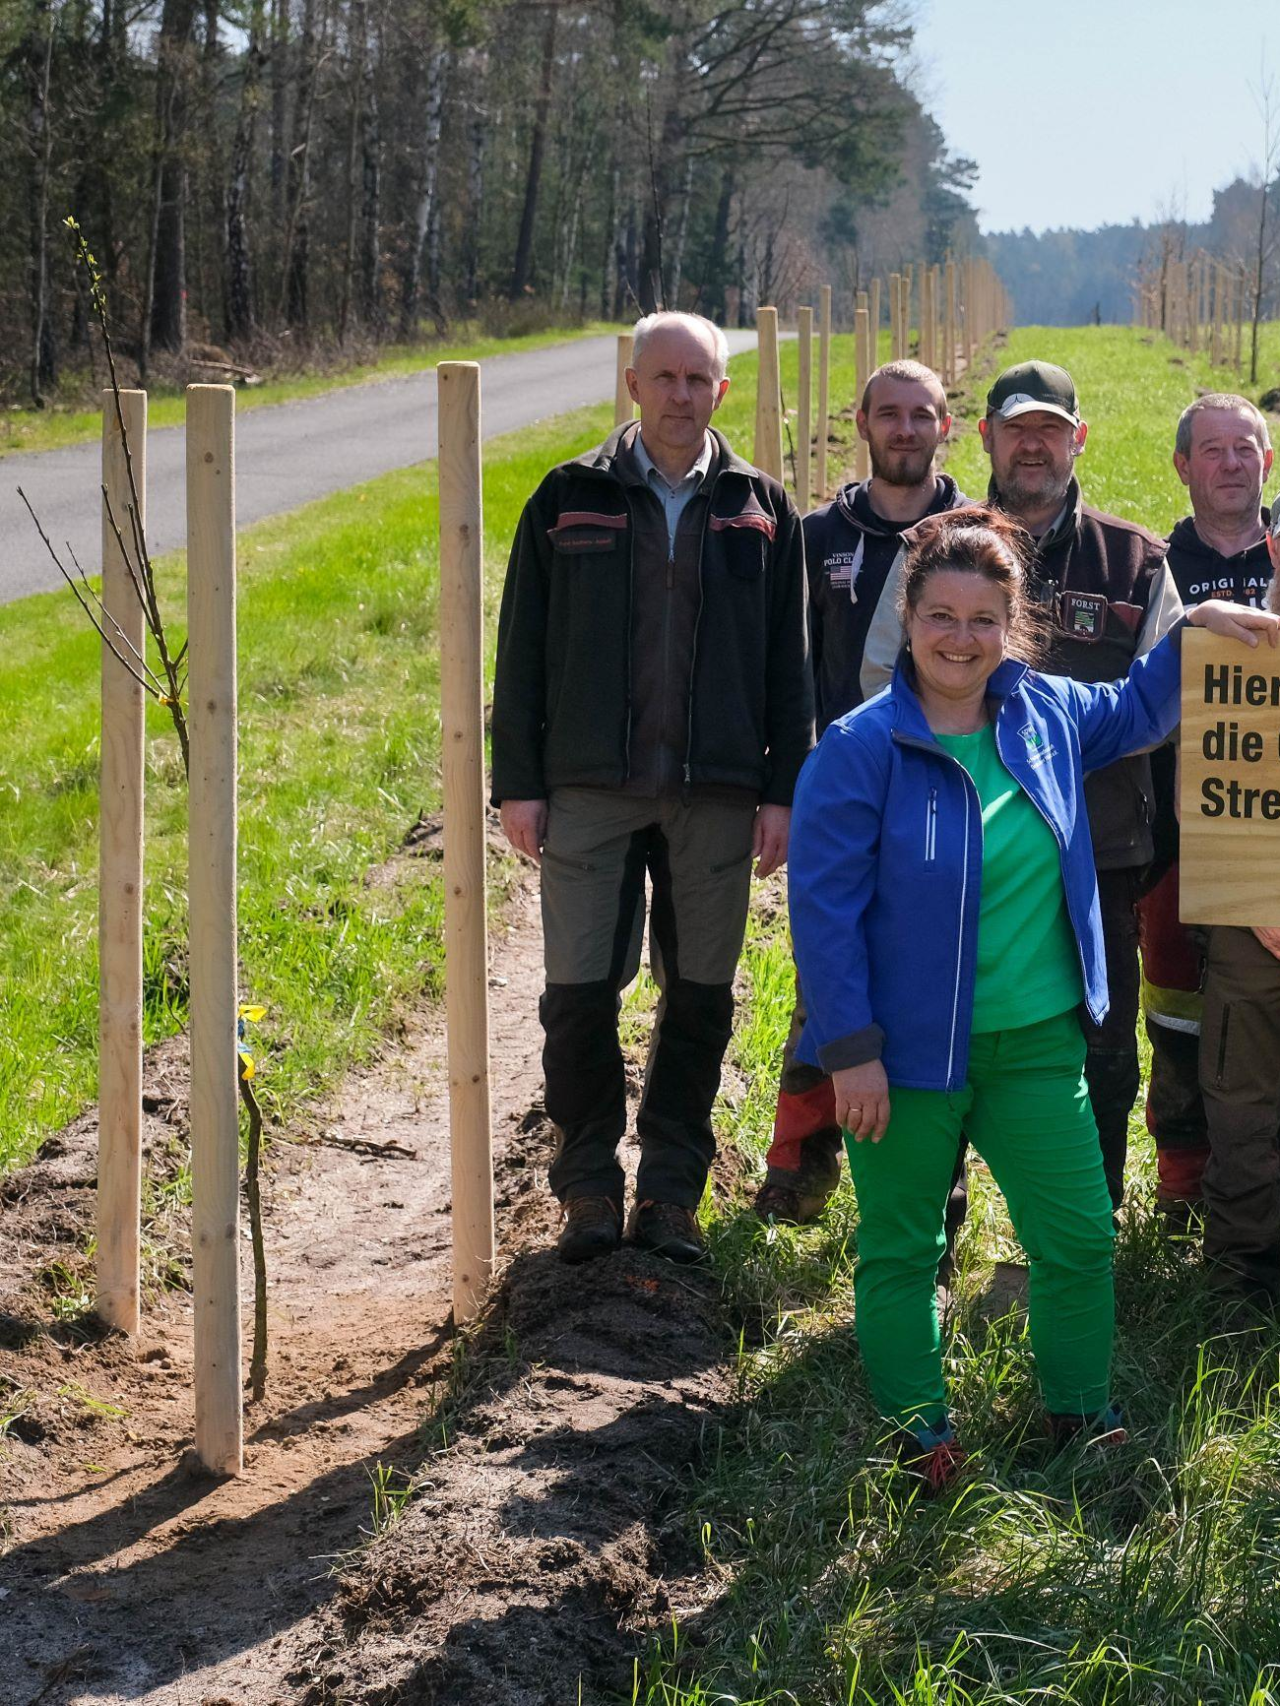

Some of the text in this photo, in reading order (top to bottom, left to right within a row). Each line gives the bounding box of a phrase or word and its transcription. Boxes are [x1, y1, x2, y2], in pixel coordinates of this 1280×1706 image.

[823, 556, 854, 567] POLO CL
[1071, 598, 1101, 611] FORST
[1203, 722, 1263, 762] die
